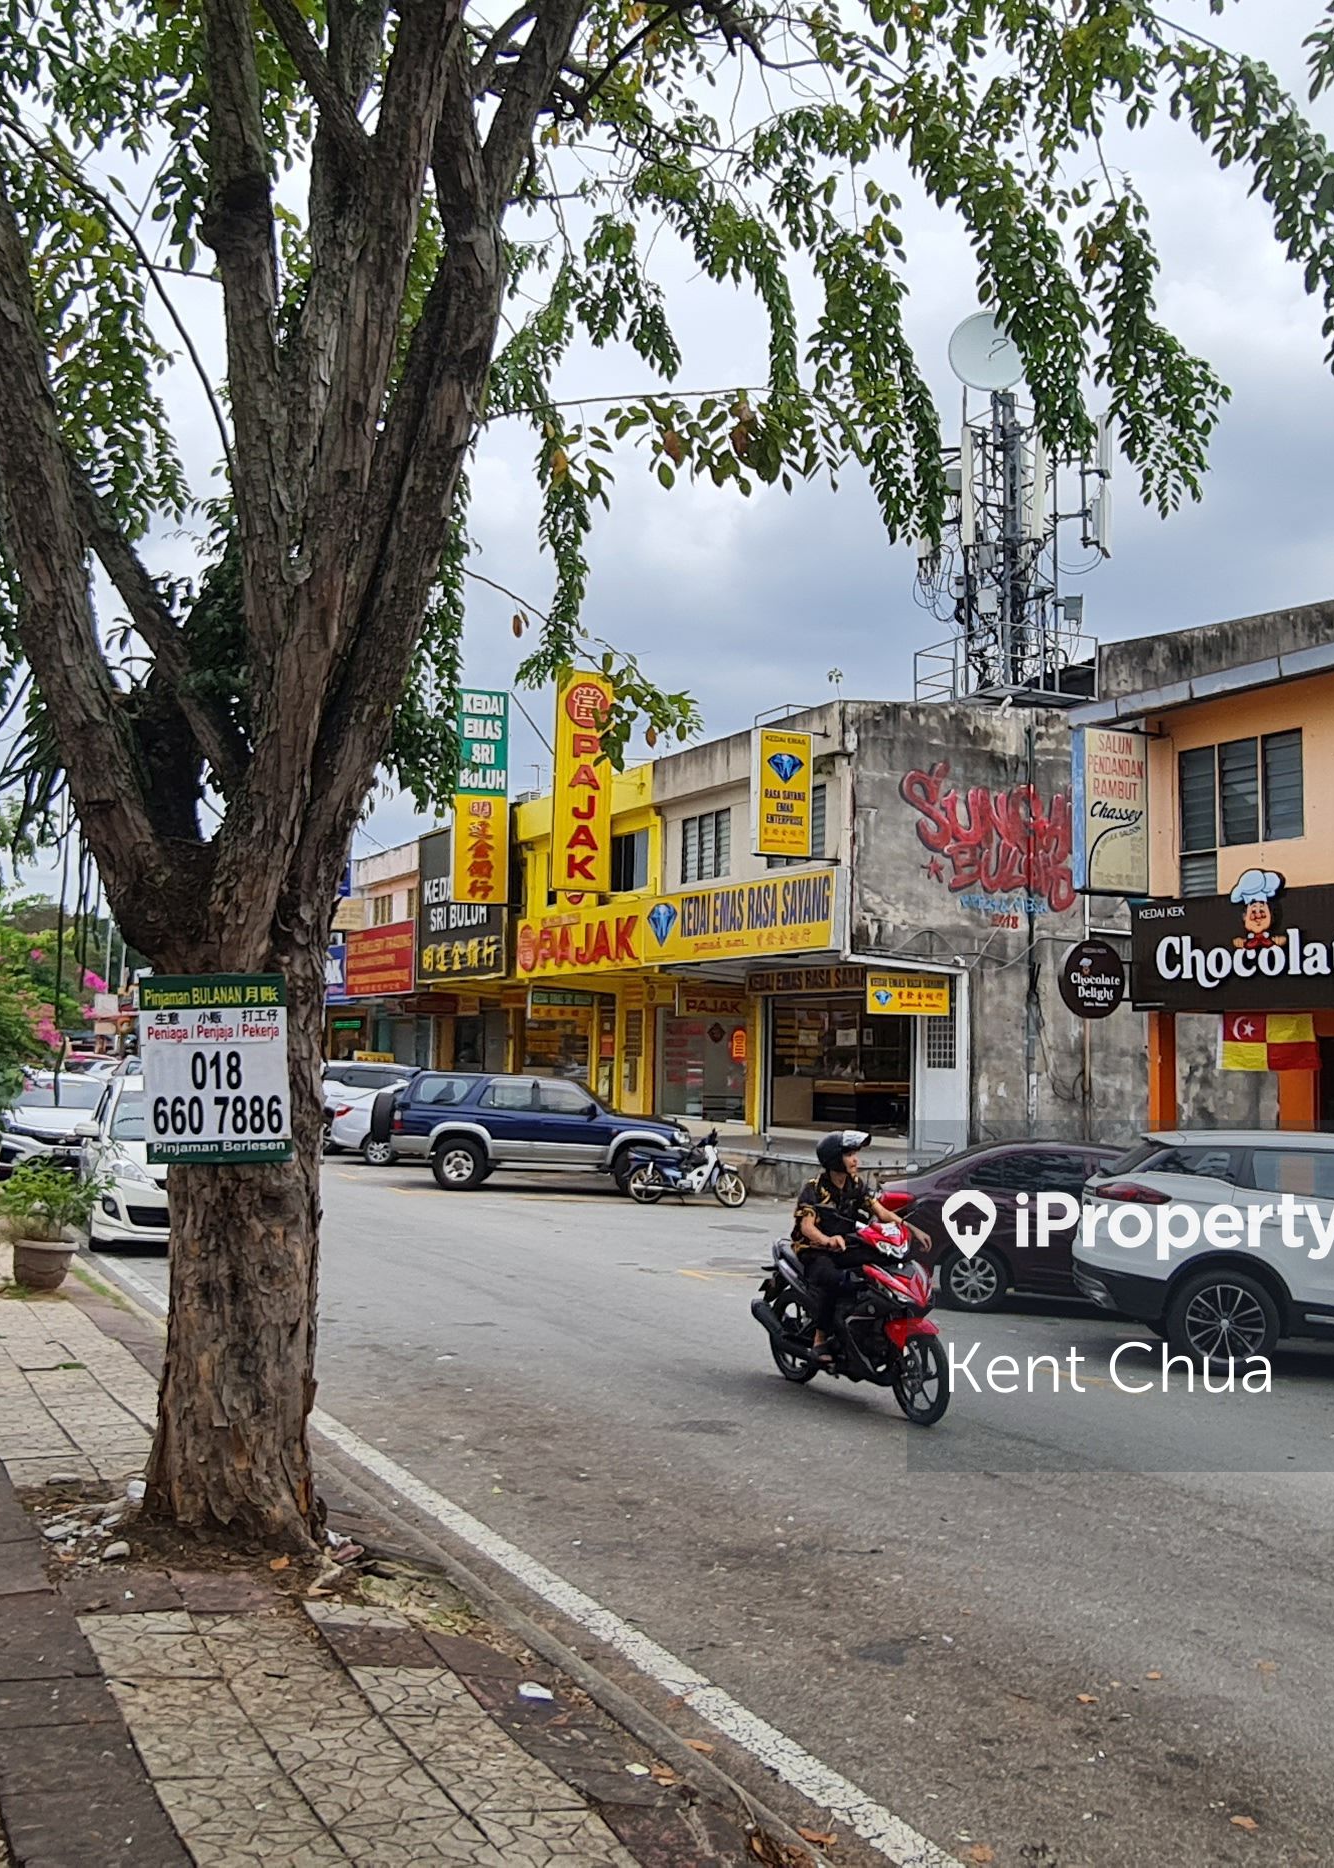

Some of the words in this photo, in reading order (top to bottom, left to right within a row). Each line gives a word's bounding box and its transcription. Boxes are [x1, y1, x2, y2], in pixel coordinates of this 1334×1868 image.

[461, 693, 504, 716] KEDAI
[463, 717, 503, 740] EMAS
[471, 743, 495, 764] SRI
[1098, 733, 1133, 756] SALUN
[1088, 754, 1144, 779] PENDANDAN
[459, 768, 506, 790] BULUH
[1093, 778, 1138, 801] RAMBUT
[568, 733, 600, 881] PAJAK
[681, 893, 711, 937] KEDAI
[713, 888, 744, 934] EMAS
[747, 883, 777, 930] RASA
[781, 875, 832, 926] SAYANG
[1139, 908, 1165, 919] KEDAI
[1166, 906, 1186, 917] KEK
[430, 907, 447, 932] SRI
[450, 904, 487, 929] BULUH
[540, 915, 640, 967] PAJAK
[1070, 972, 1121, 986] Chocolate
[144, 989, 189, 1009] Pinjaman
[192, 987, 242, 1005] BULANAN
[1078, 986, 1114, 1001] Delight
[155, 1012, 180, 1026] 生意
[242, 1009, 278, 1022] 打工仔
[148, 1025, 188, 1043] Peniaga
[197, 1024, 233, 1042] Penjaja
[242, 1023, 279, 1041] Pekerja
[191, 1051, 242, 1090] 018
[153, 1096, 204, 1135] 660
[214, 1095, 283, 1135] 7886
[153, 1143, 219, 1155] Pinjaman
[223, 1140, 285, 1151] Berlesen
